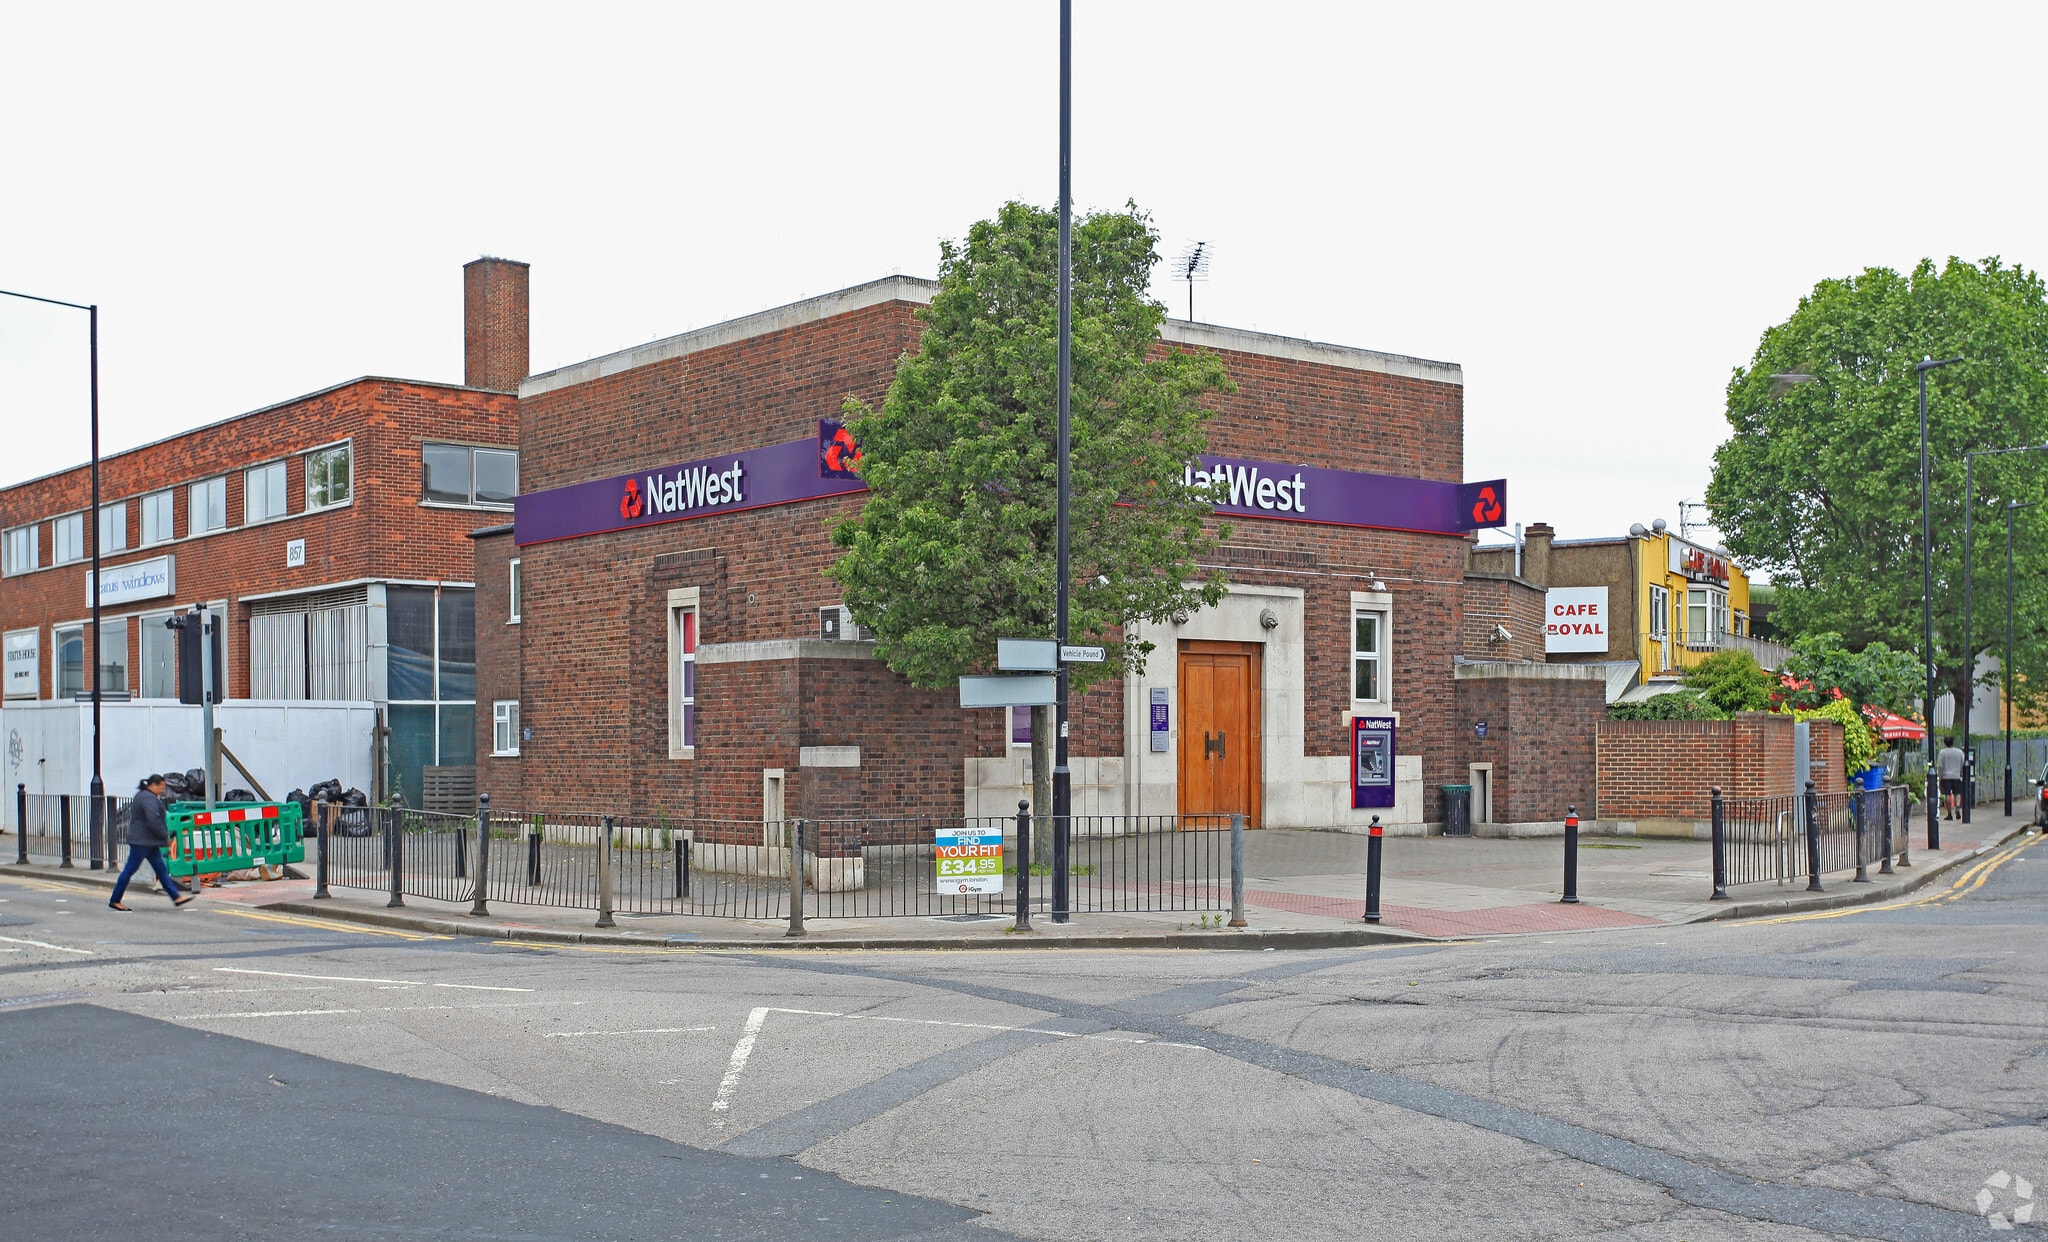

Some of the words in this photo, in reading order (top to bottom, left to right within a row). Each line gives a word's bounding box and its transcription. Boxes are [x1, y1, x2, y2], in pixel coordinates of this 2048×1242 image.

[647, 460, 743, 515] NatWest
[290, 546, 302, 561] 857
[122, 571, 166, 590] windows
[1553, 604, 1598, 617] CAFE
[1063, 649, 1081, 658] Vehicle
[1082, 649, 1099, 658] Pound
[1366, 720, 1392, 729] NatWest
[958, 837, 980, 846] FIND
[940, 845, 978, 857] YOUR
[980, 845, 999, 856] FIT
